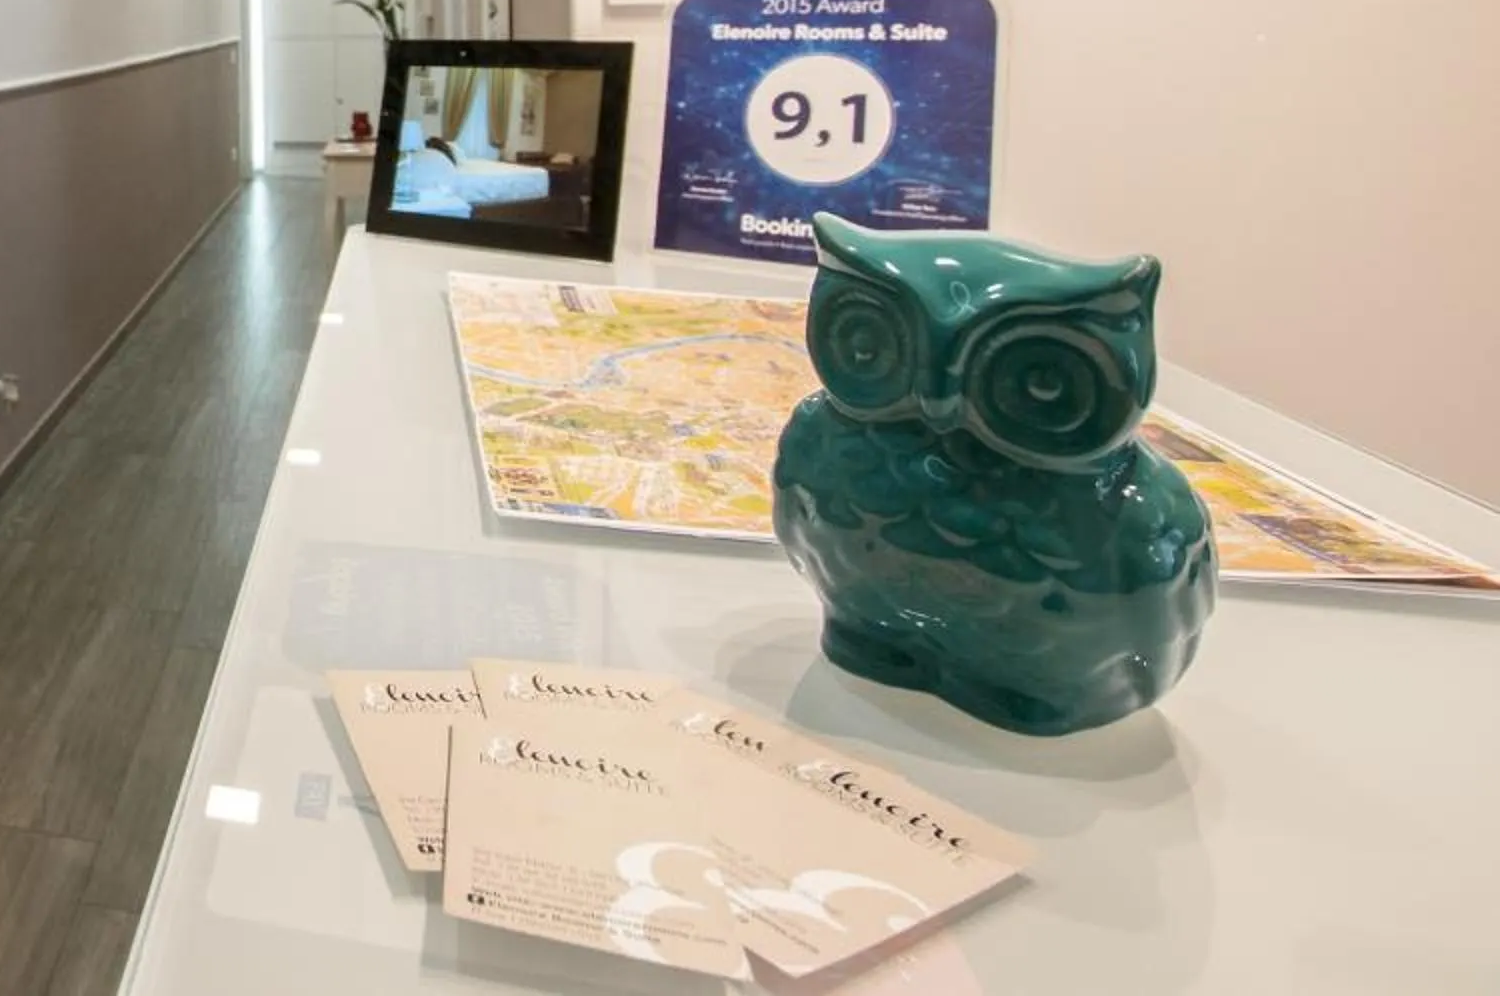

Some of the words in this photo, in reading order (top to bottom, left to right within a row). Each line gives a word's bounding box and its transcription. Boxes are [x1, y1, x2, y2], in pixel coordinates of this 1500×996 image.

[710, 23, 792, 42] Elenoire
[794, 23, 865, 42] Rooms
[867, 23, 888, 42] &
[890, 22, 949, 42] Suite
[770, 90, 869, 148] 9,1
[739, 213, 814, 238] Bookin
